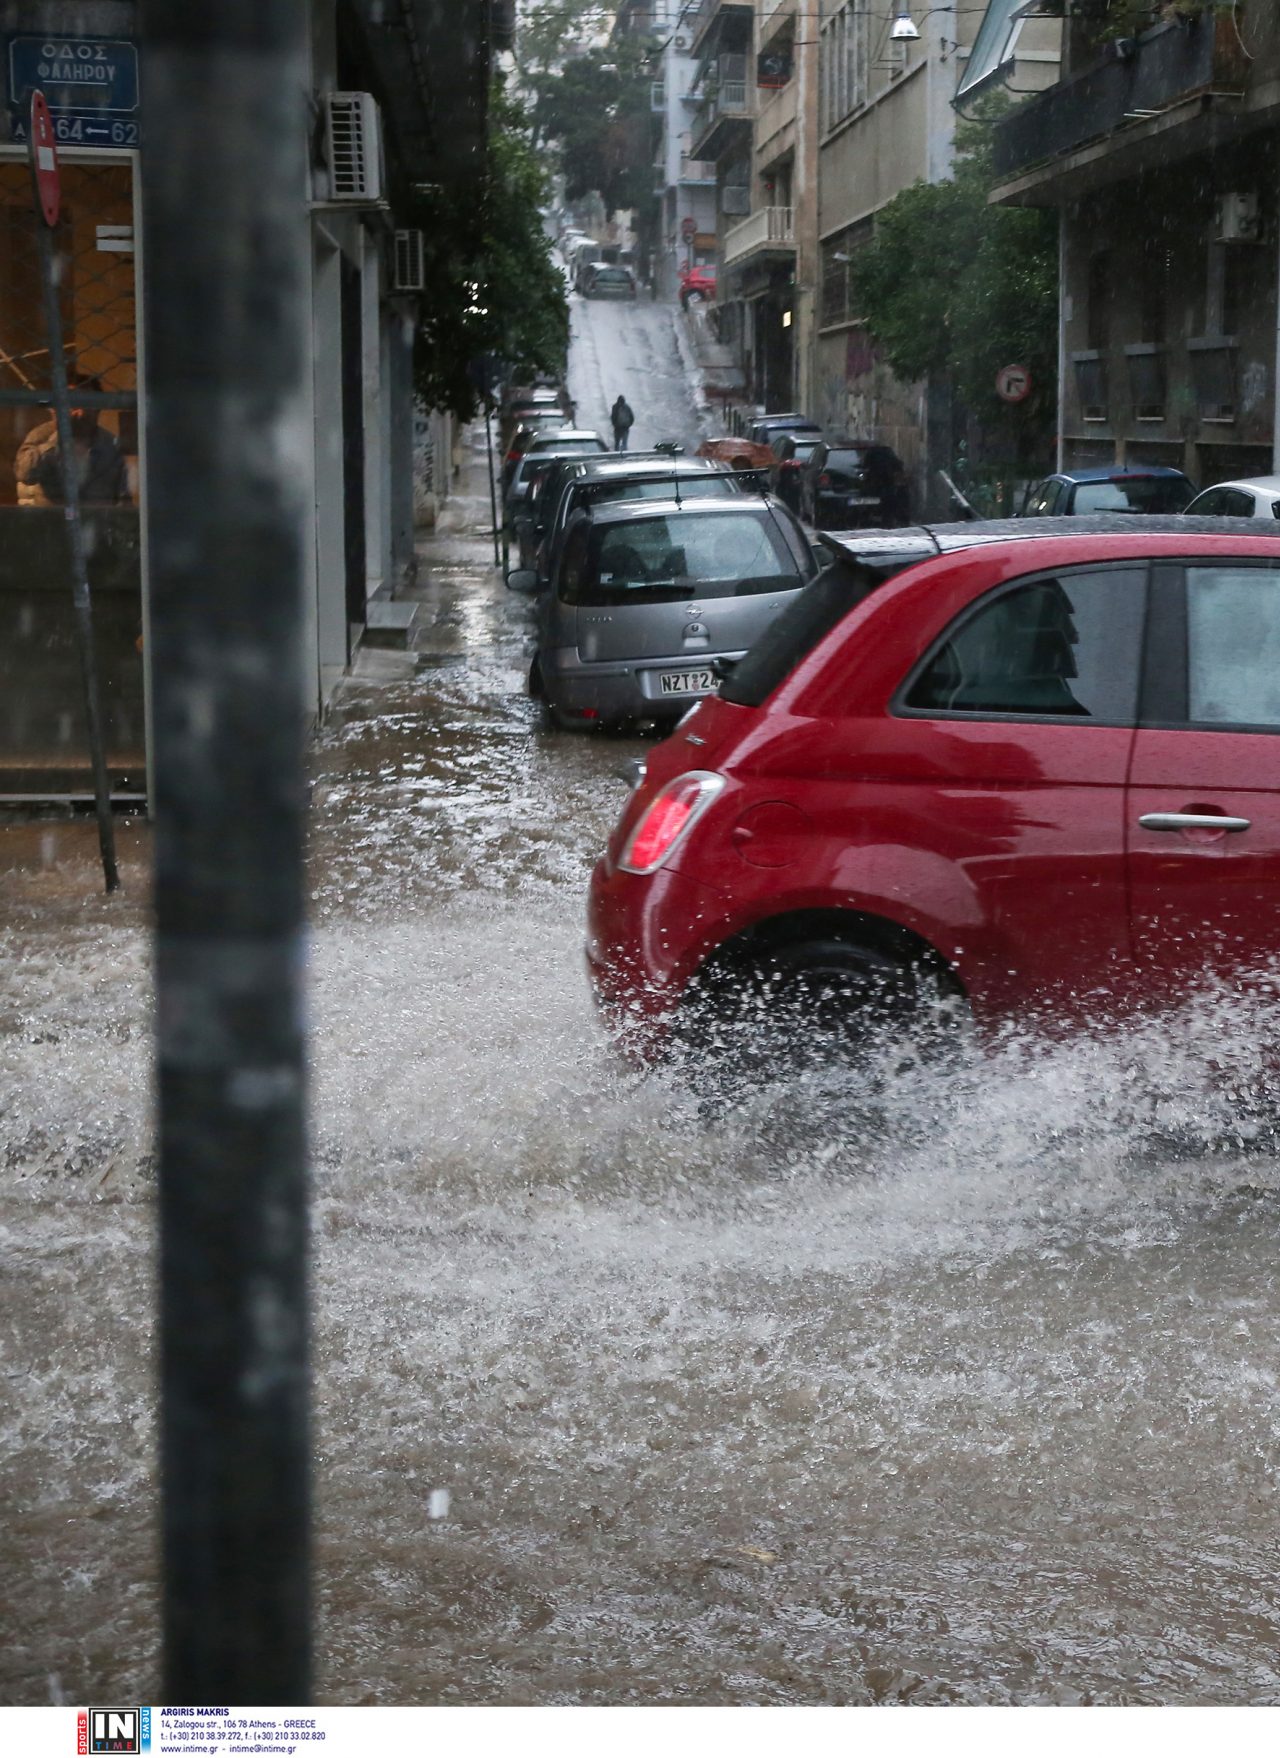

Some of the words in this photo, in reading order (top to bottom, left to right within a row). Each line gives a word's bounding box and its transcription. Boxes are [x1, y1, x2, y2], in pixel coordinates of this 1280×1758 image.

[41, 44, 107, 60] ΟΔΟΣ
[37, 62, 116, 81] ΦΑΛΗΡΟΥ
[56, 119, 83, 140] 64
[112, 122, 137, 144] 62
